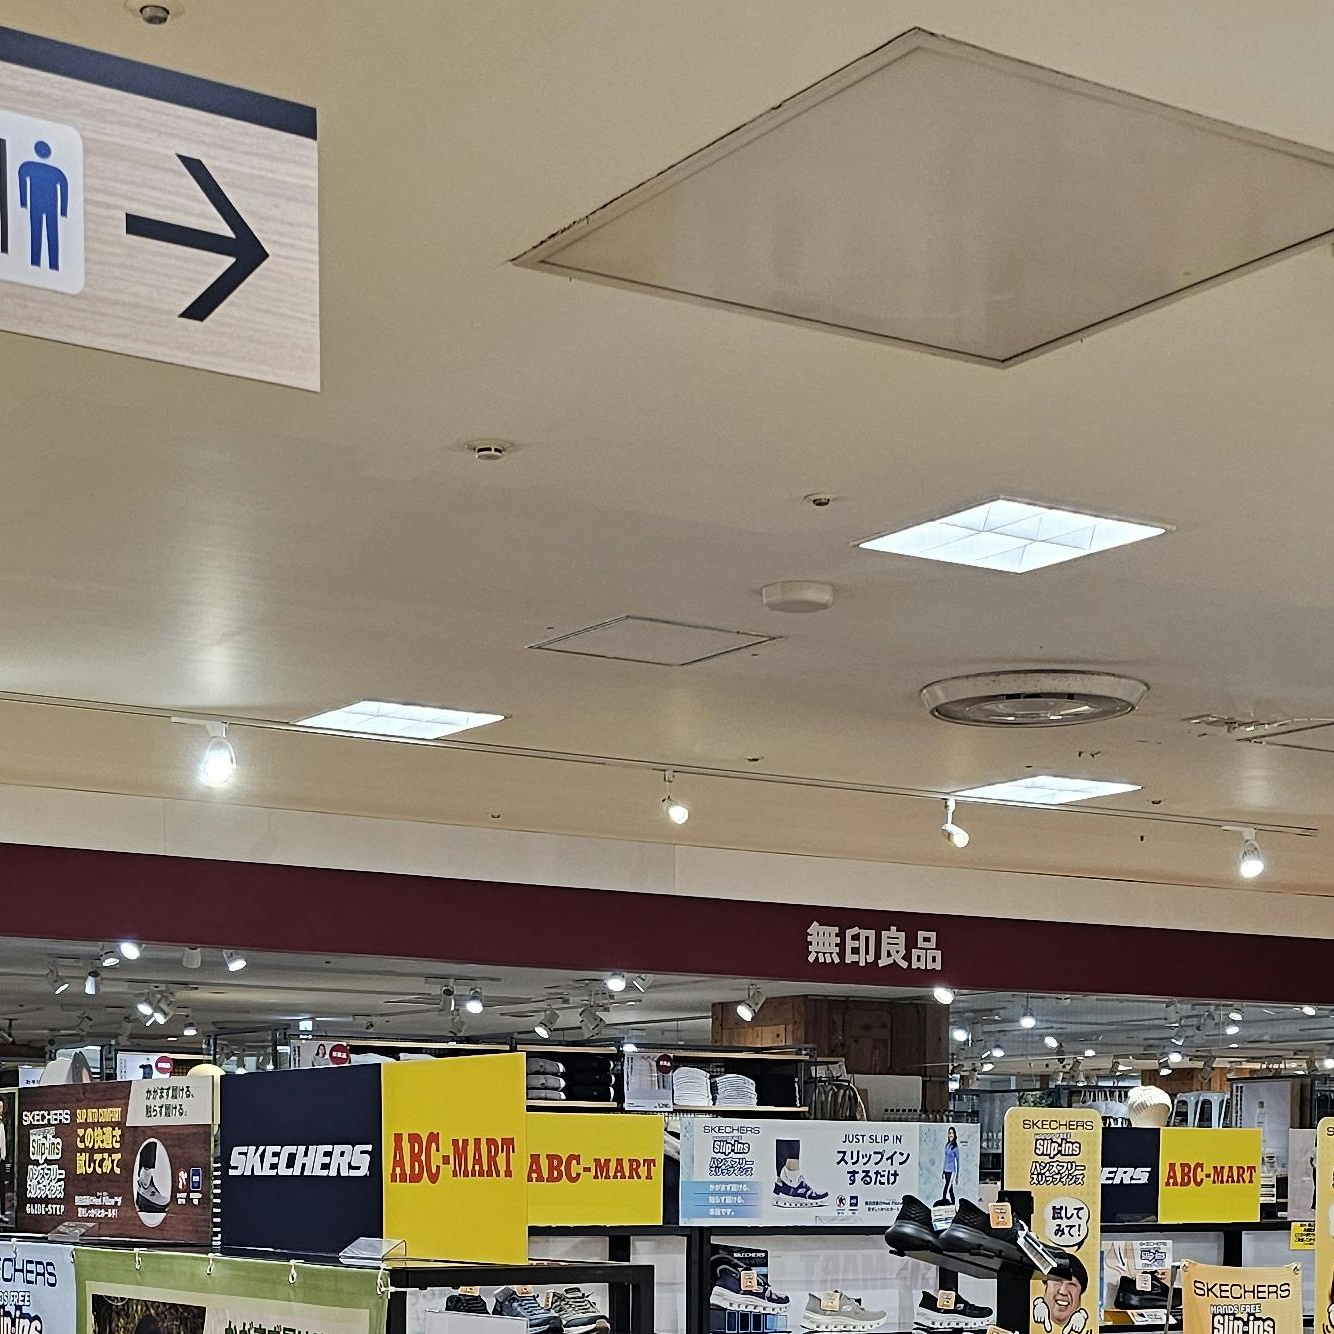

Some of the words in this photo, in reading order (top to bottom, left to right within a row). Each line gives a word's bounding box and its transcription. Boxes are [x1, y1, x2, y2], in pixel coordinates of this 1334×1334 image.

[807, 920, 942, 970] 無印良品
[22, 1109, 71, 1125] SKECHERS
[1022, 1119, 1094, 1131] SKECHERS
[703, 1125, 761, 1134] SKECHERS
[843, 1134, 866, 1144] JUST
[869, 1134, 890, 1144] SLIP
[892, 1135, 903, 1144] IN
[1034, 1138, 1081, 1158] Slip-ins
[229, 1143, 372, 1177] SKECHERS
[390, 1132, 516, 1184] ABC-MART
[836, 1149, 911, 1166] スリップイン
[526, 1153, 656, 1183] ABC-MART
[1165, 1162, 1257, 1187] ABC-MART
[846, 1169, 900, 1186] するだけ
[26, 1203, 65, 1216] GLIDE-STEP
[1193, 1280, 1291, 1300] SKECHERS
[1210, 1304, 1238, 1314] HANDS
[1241, 1304, 1261, 1314] FREE
